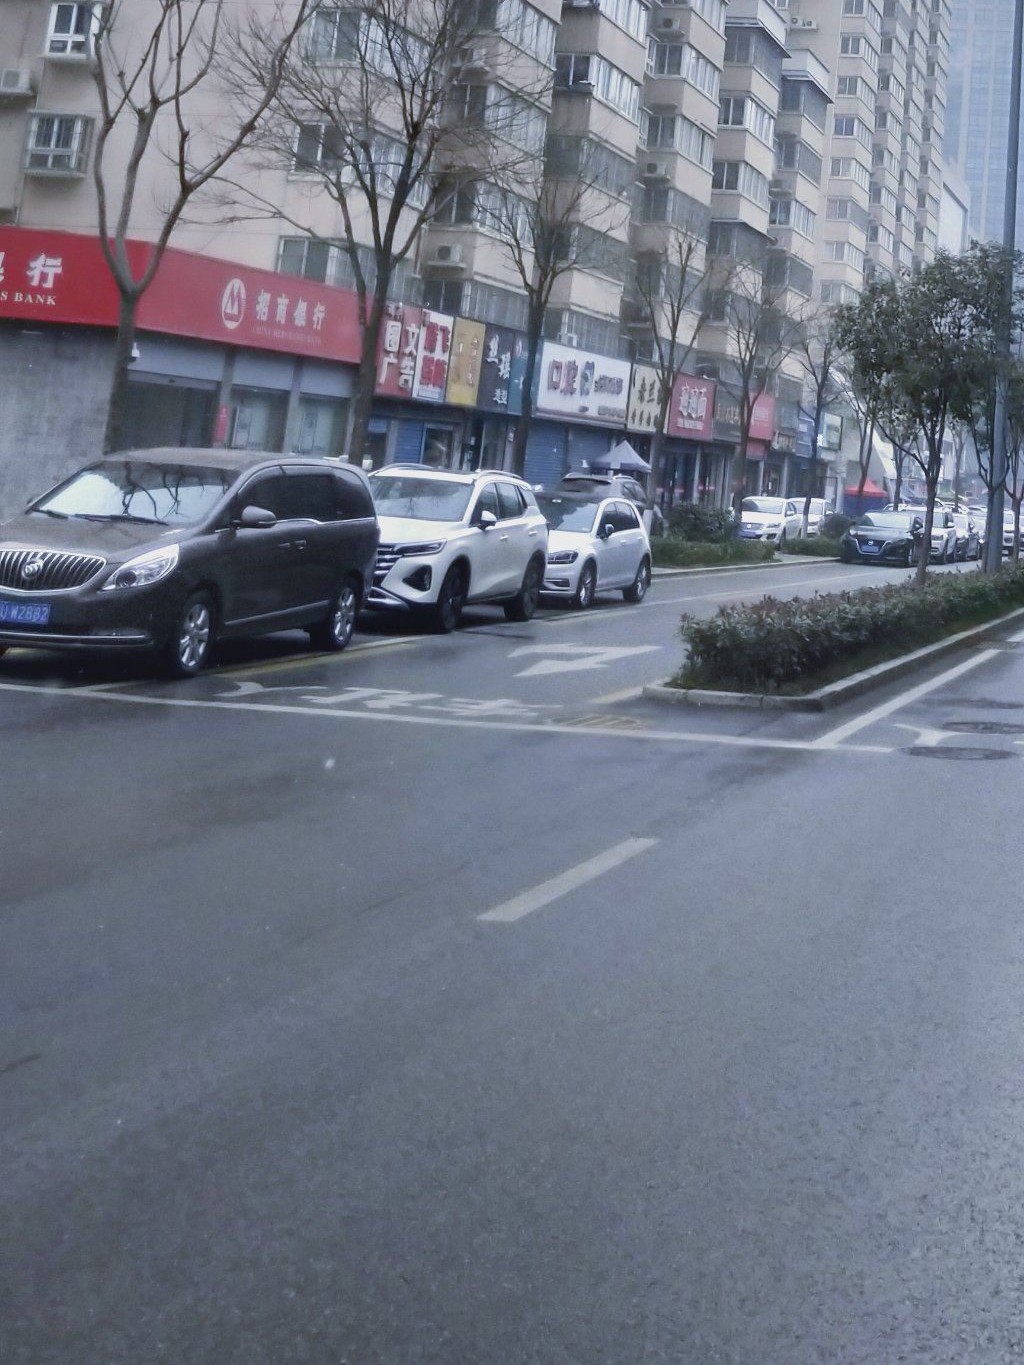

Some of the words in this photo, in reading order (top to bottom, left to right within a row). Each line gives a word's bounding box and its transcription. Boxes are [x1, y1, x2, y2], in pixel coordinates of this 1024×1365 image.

[0, 251, 63, 289] 行
[14, 292, 57, 305] BANK
[256, 289, 326, 331] 招商银行
[379, 353, 416, 391] 广告
